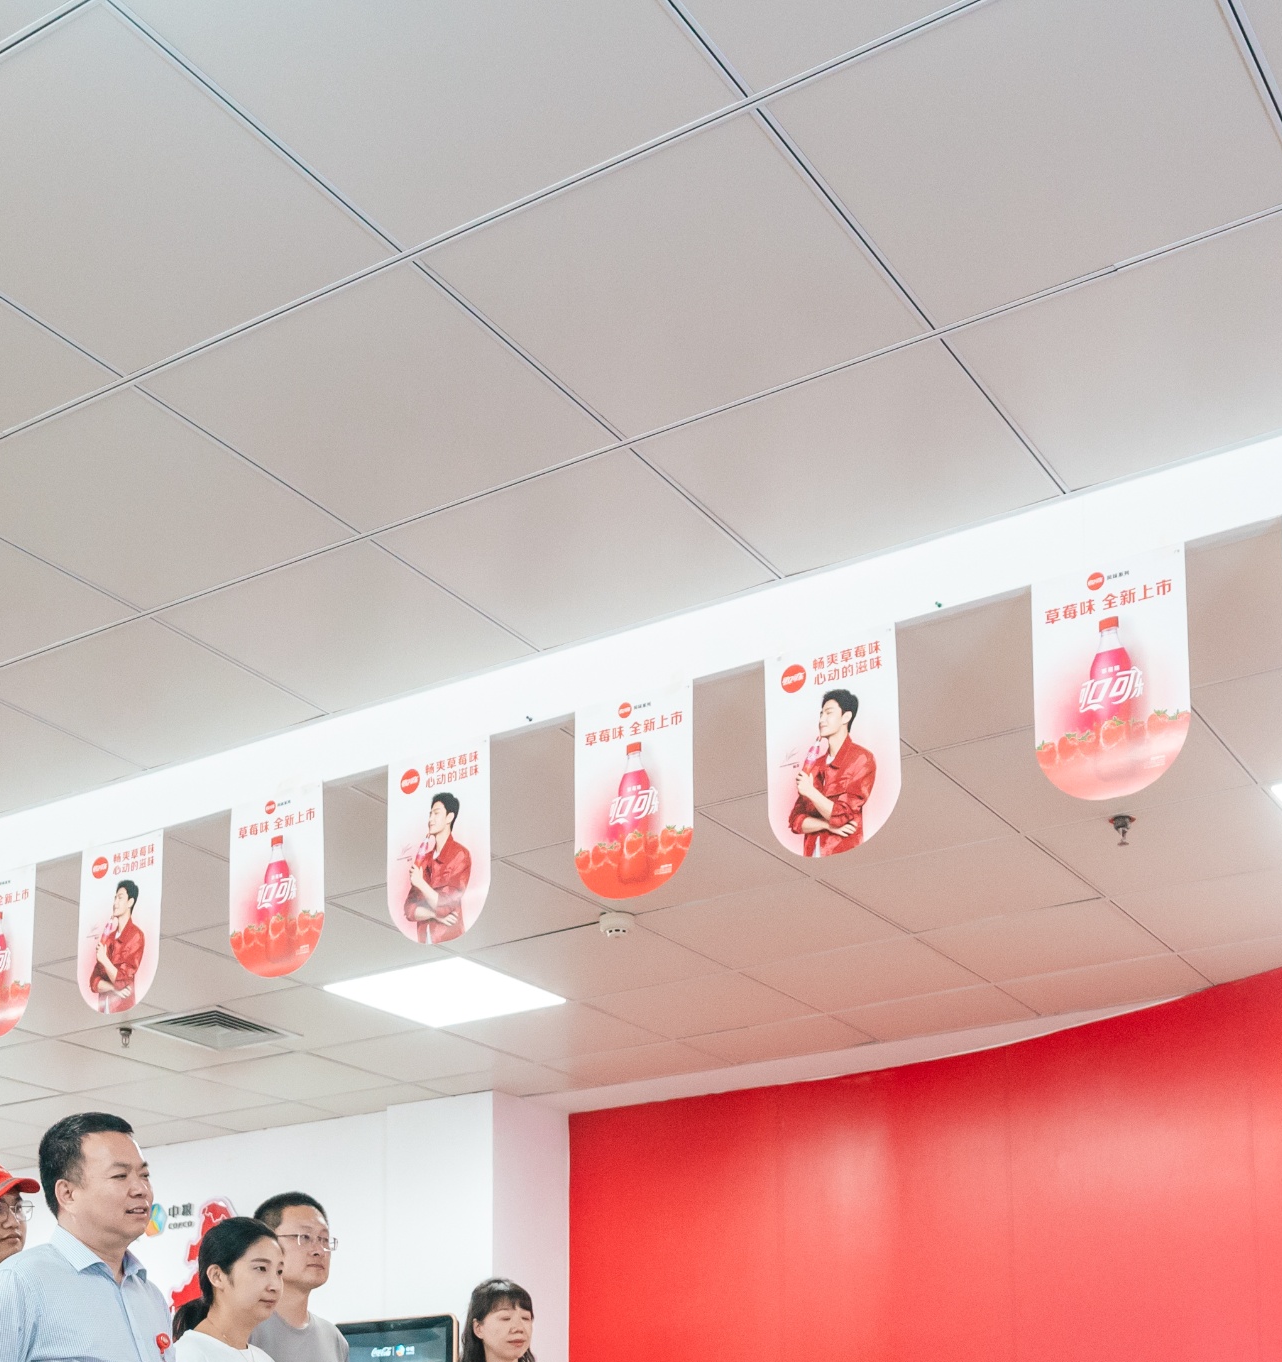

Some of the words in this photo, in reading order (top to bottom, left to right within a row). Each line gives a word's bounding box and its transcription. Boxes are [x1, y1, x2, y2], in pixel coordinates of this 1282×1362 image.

[1044, 599, 1096, 625] 草莓味
[1102, 578, 1173, 611] 全新上市
[812, 640, 882, 671] 畅爽草莓味
[813, 655, 883, 686] 心动的滋味
[1079, 666, 1145, 713] 可口可乐
[585, 725, 625, 747] 草莓味
[629, 711, 683, 737] 全新上市
[424, 751, 479, 776] 畅爽草莓味
[425, 764, 480, 789] 心动的滋味
[609, 786, 660, 825] 可口可乐
[238, 822, 269, 840] 草莓味
[273, 807, 316, 831] 全新上市
[168, 1202, 193, 1218] 中粮
[168, 1220, 194, 1231] COFCO
